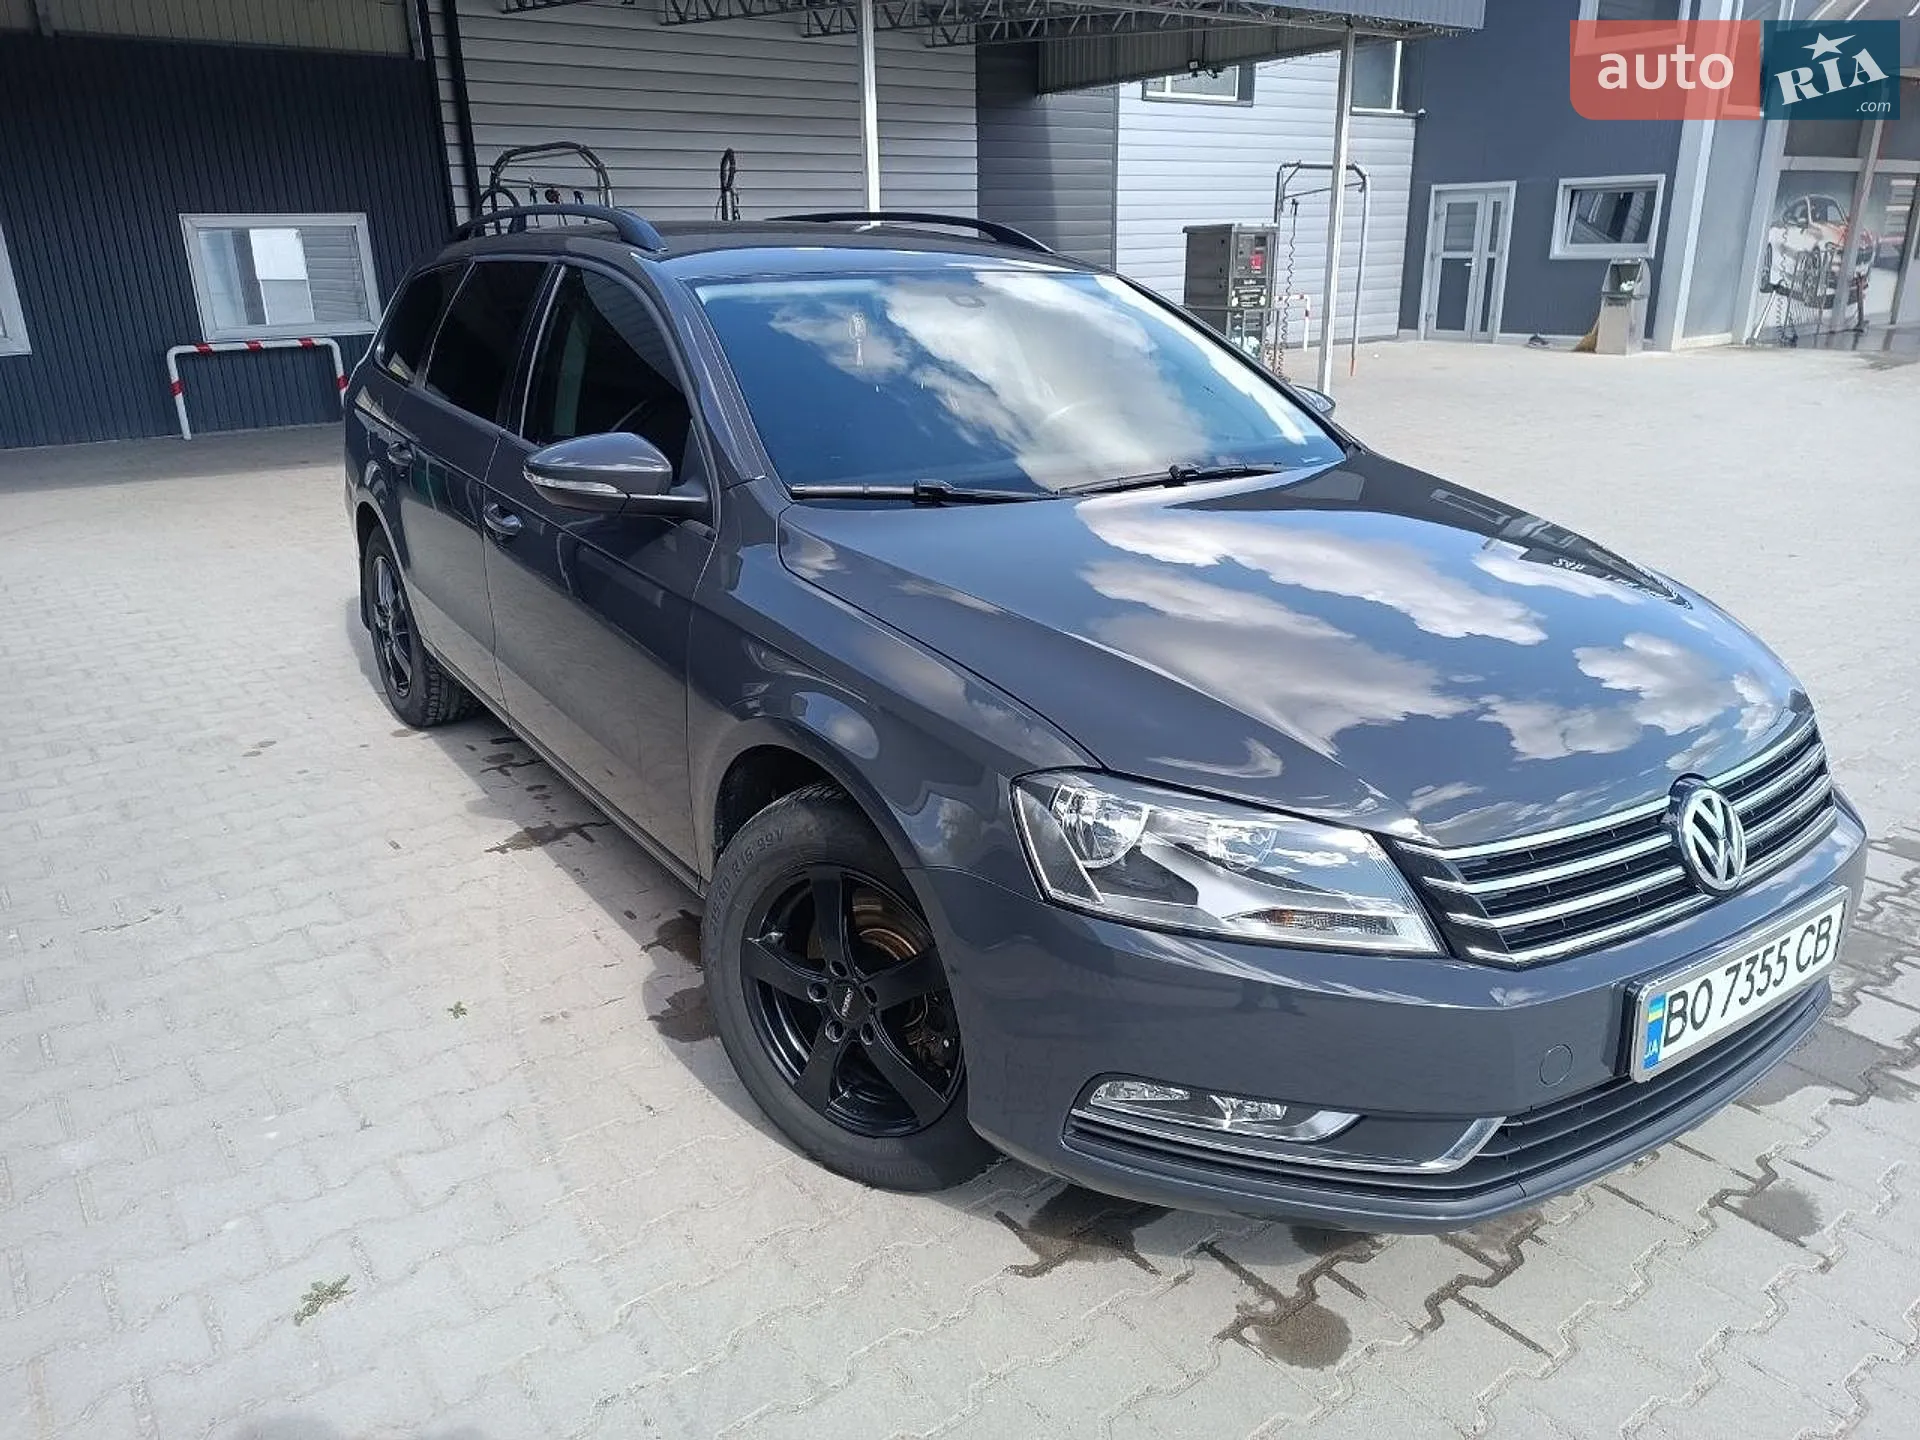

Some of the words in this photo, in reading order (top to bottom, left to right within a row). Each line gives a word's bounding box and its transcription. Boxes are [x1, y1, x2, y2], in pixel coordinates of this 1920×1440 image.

[1663, 978, 1713, 1048] BO
[1720, 937, 1791, 1018] 7355
[1795, 914, 1833, 974] CB
